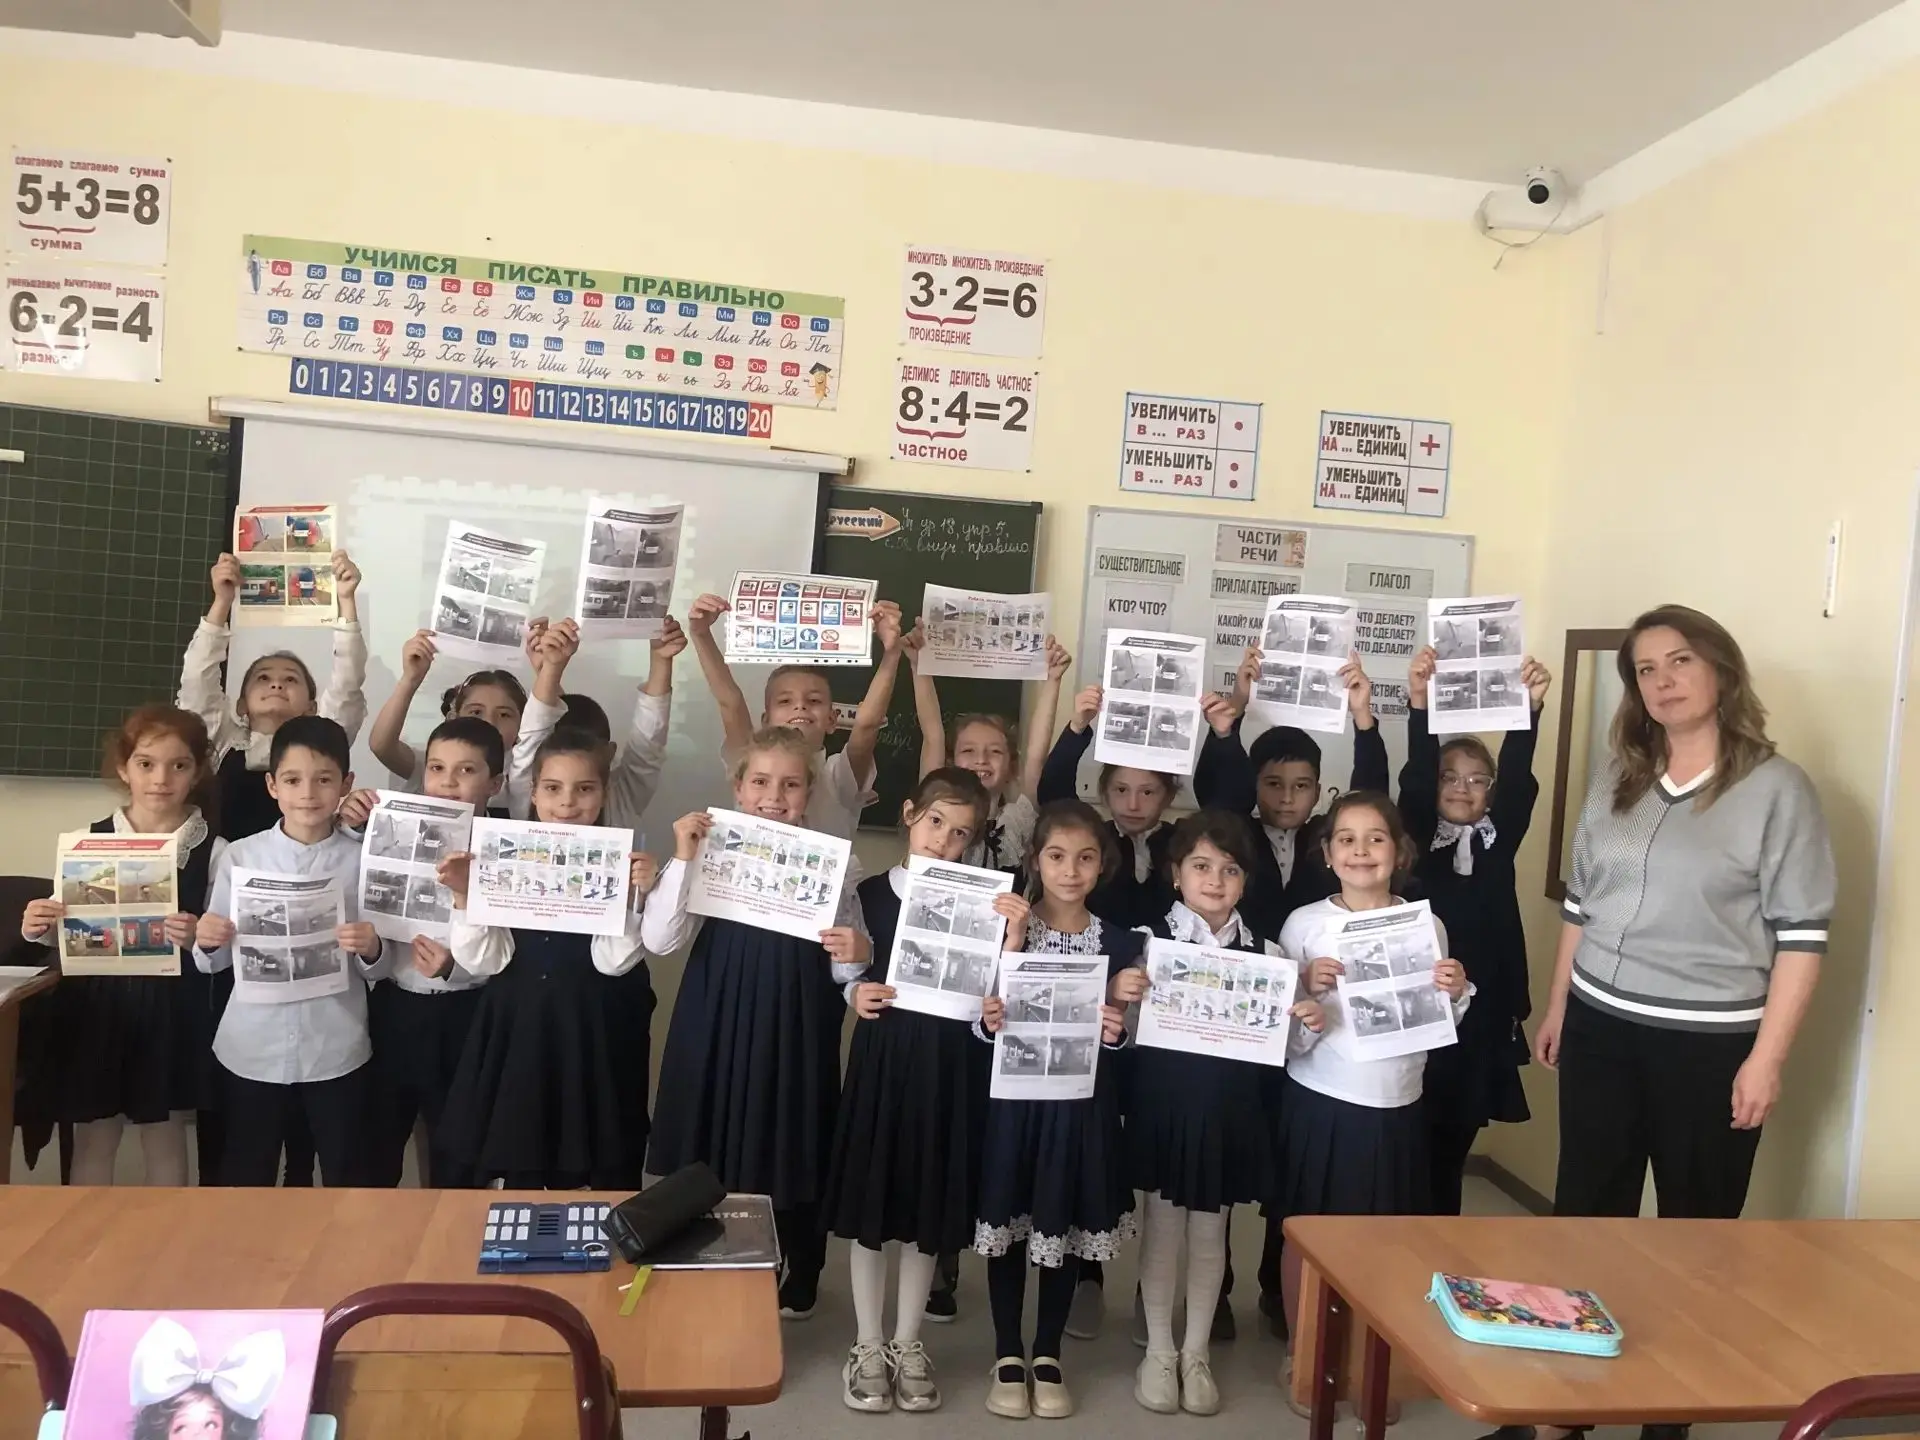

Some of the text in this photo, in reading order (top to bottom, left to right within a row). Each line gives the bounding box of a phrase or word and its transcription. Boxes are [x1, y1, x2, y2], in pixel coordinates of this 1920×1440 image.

[70, 161, 120, 174] слагаемое
[130, 166, 166, 178] сумма
[16, 173, 160, 225] 5+3=8
[30, 238, 82, 250] сумма
[908, 250, 1044, 278] МНОЖИТЕЛЬ МНОЖИТЕЛЬ ПРОИЗВЕДЕНИЕ
[344, 247, 785, 310] УЧИМСЯ ПИСАТЬ ПРАВИЛЬНО
[116, 287, 160, 298] разность
[909, 326, 972, 345] ПРОИЗВЕДЕНИЕ
[902, 365, 1032, 392] ДЕЛИМОЕ ДЕЛИТЕЛЬ ЧАСТНОЕ
[296, 364, 770, 432] 0 1 2 3 4 5 6 7 8 9 10 11 12 13 14 15 16 17 18 19 20
[1131, 402, 1216, 424] УВЕЛИЧИТЬ
[1137, 424, 1206, 440] В РАЗ
[1330, 420, 1400, 440] УВЕЛИЧИТЬ
[898, 442, 968, 462] частное
[1321, 436, 1407, 460] НА ЕДИНИЦ
[1126, 448, 1212, 470] УМЕНЬШИТЬ
[1134, 470, 1202, 486] В РАЗ
[1326, 466, 1402, 486] УМЕНЬШИТЬ
[1320, 482, 1405, 506] НА ЕДИНИЦ
[1238, 530, 1281, 546] ЧАСТИ
[1240, 547, 1278, 562] РЕЧИ
[1100, 554, 1182, 576] СУЩЕСТВИТЕЛЬНОЕ
[1215, 578, 1297, 596] ПРИЛАГАТЕЛЬНОЕ
[1369, 572, 1411, 590] ГЛАГОЛ
[1108, 598, 1167, 616] КТО? ЧТО?
[1218, 614, 1248, 628] КАКОЙ?
[1357, 612, 1415, 626] ЧТО ДЕЛАЕТ?
[1216, 633, 1246, 647] КАКОЕ?
[1356, 626, 1416, 640] ЧТО СДЕЛАЕТ?
[1354, 640, 1414, 655] ЧТО ДЕЛАЛИ?
